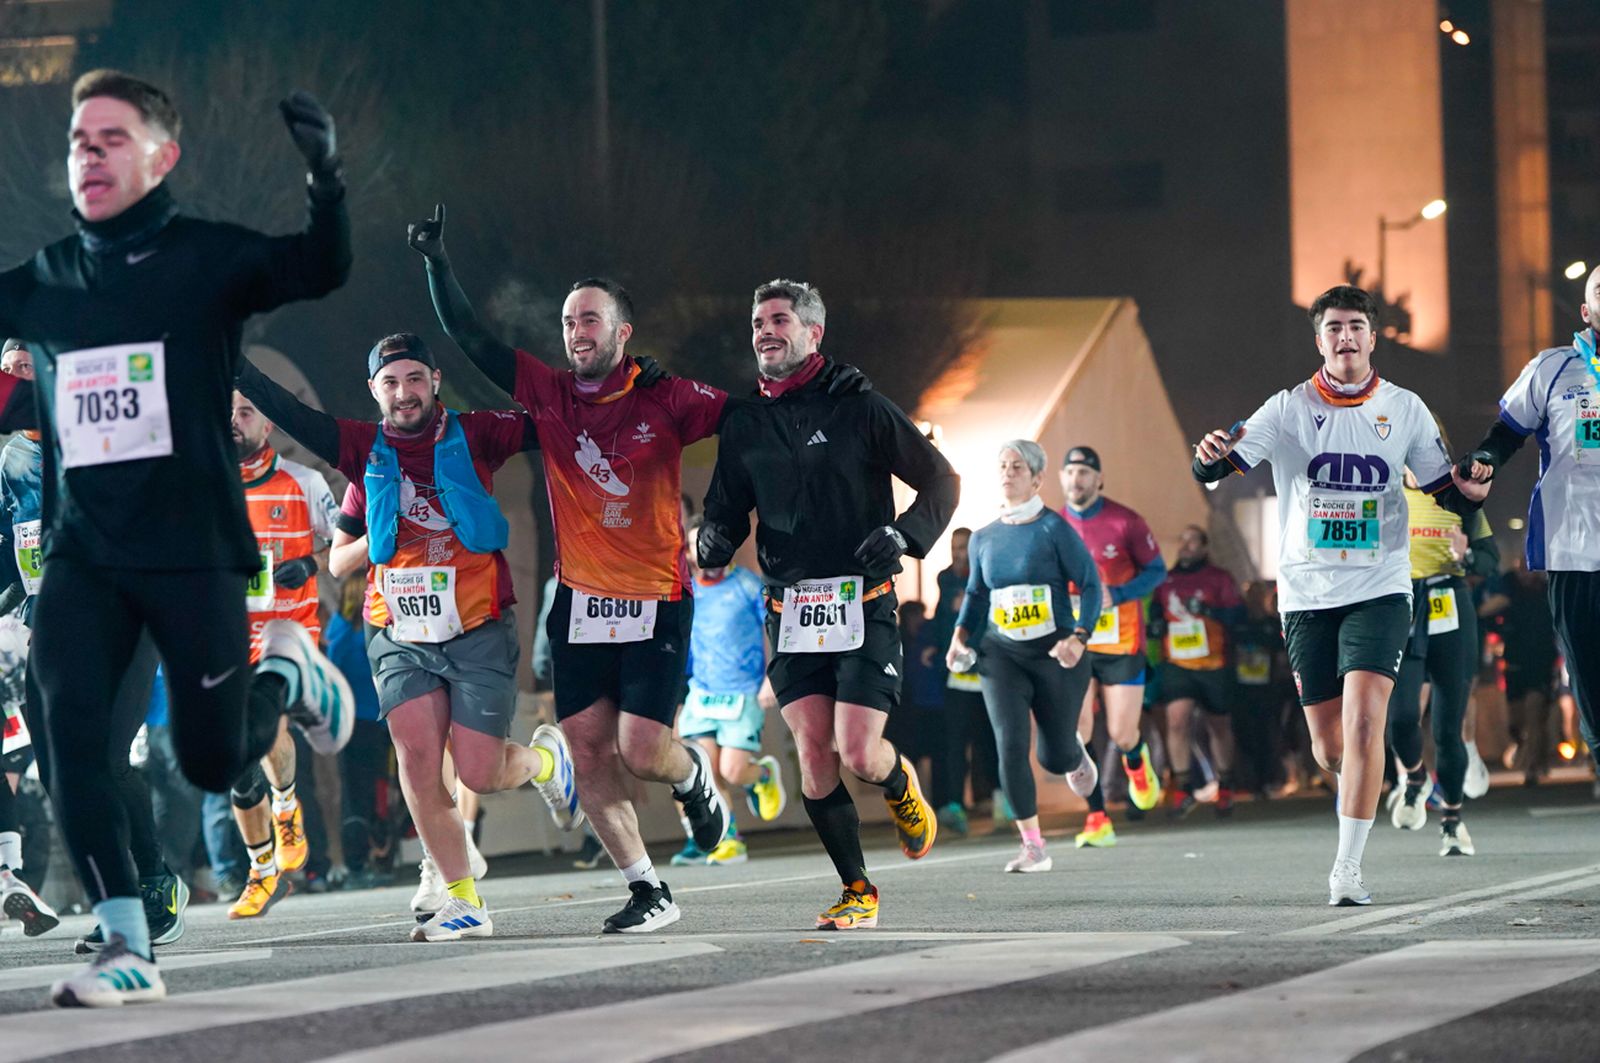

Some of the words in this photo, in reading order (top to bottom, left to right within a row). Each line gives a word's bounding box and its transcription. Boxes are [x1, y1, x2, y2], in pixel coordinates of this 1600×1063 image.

[74, 387, 139, 425] 7033
[589, 463, 610, 483] 43
[408, 503, 430, 522] 43
[1313, 510, 1328, 518] SAN
[1321, 519, 1367, 541] 7851
[397, 595, 441, 616] 6679
[587, 596, 642, 618] 6680
[794, 594, 809, 604] SAN
